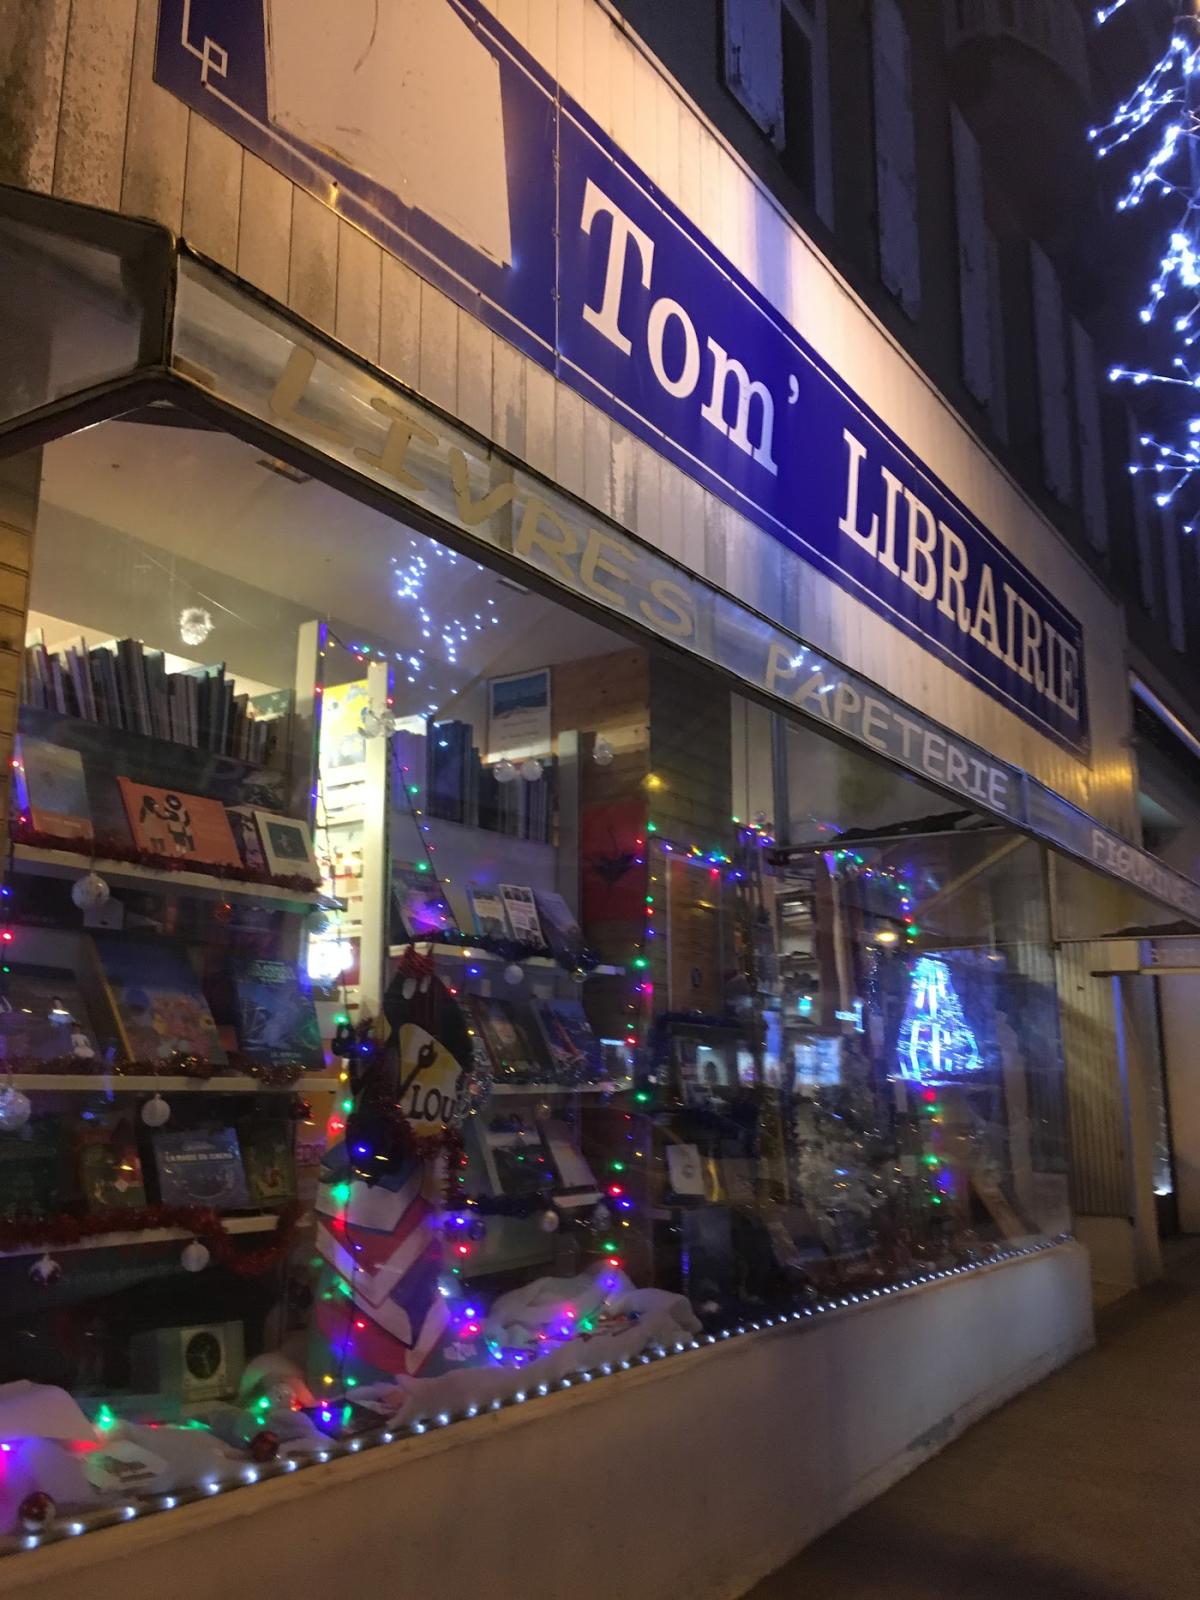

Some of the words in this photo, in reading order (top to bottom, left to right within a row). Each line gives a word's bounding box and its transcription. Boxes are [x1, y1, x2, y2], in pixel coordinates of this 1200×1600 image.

[270, 343, 696, 637] LIVRES
[764, 641, 1009, 811] PAPETERIE
[580, 177, 800, 477] Tom'
[838, 427, 1080, 721] LIBRAIRIE
